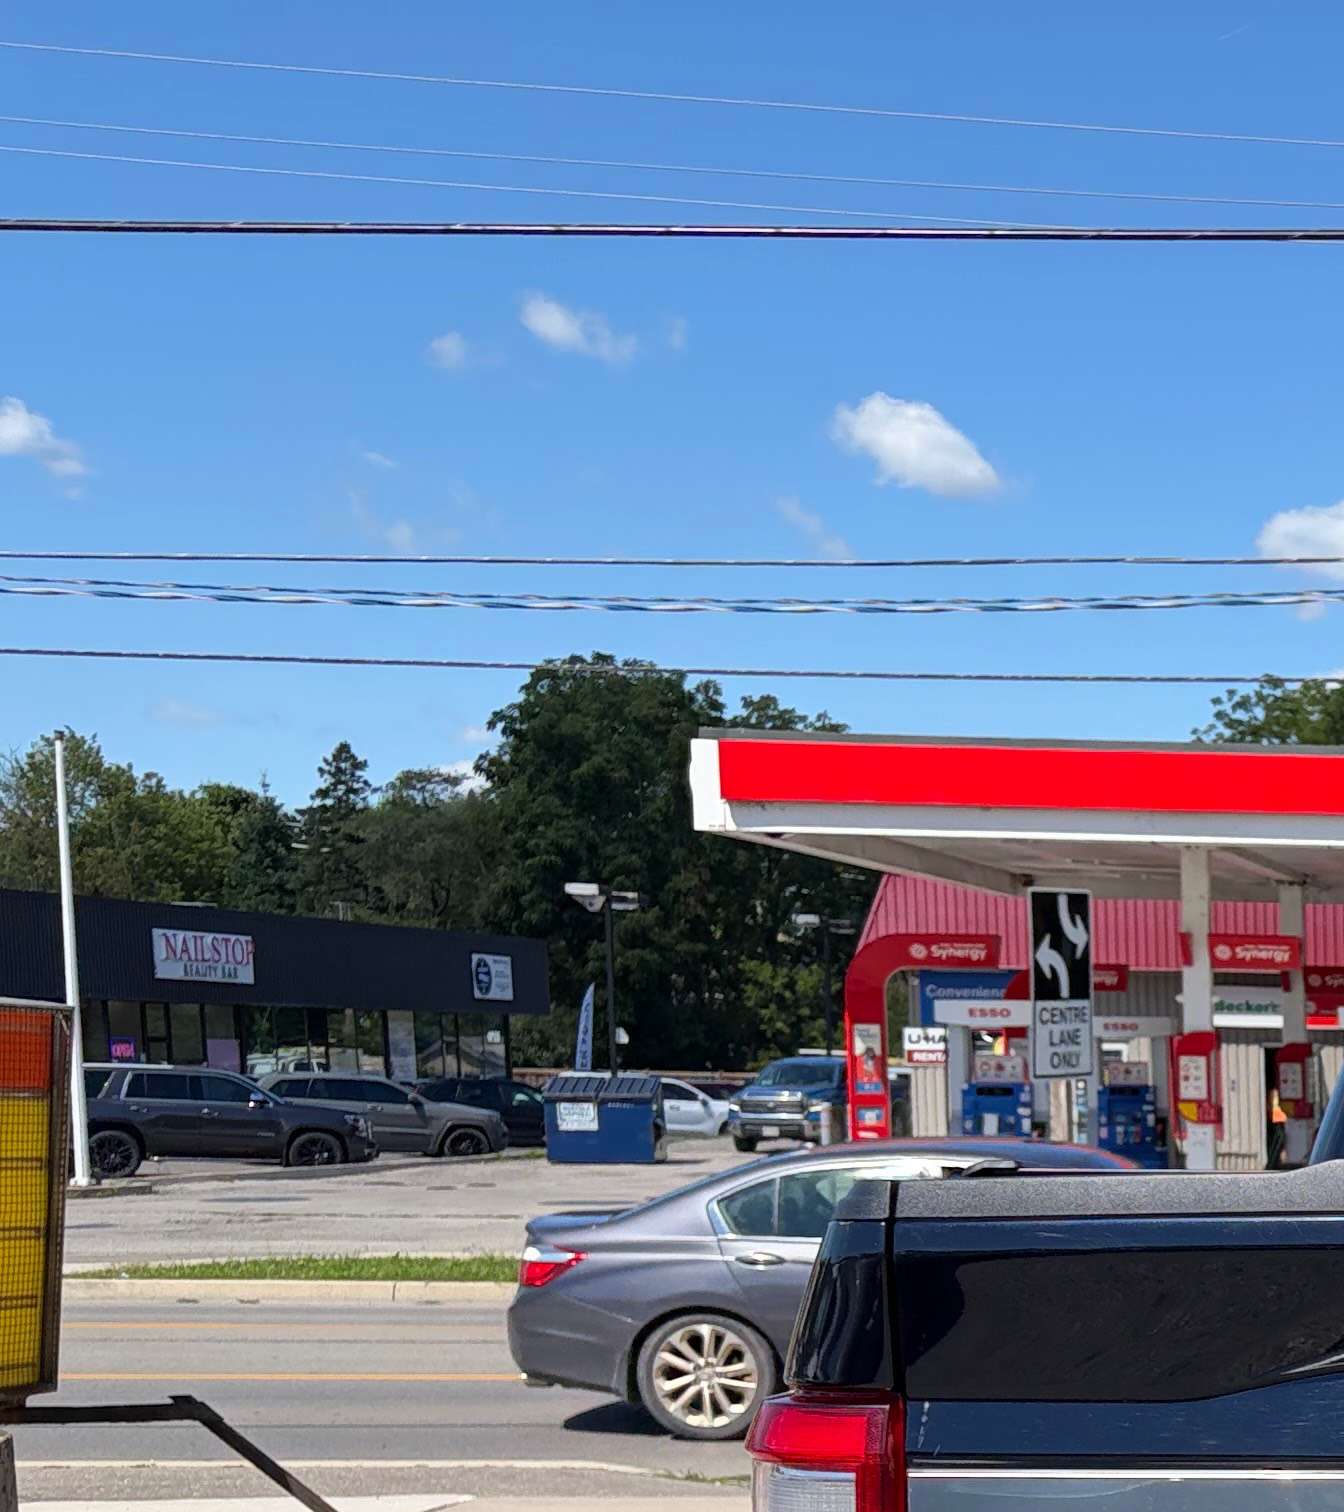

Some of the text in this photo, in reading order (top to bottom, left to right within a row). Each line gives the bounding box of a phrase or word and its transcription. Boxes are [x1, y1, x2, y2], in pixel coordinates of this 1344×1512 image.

[931, 944, 987, 961] Synergy
[1235, 946, 1291, 962] Synergy
[968, 1007, 1011, 1018] ESSO
[1039, 1006, 1088, 1025] CENTRE
[1103, 1022, 1138, 1031] ESSO
[1049, 1028, 1081, 1047] LANE
[1050, 1051, 1080, 1069] ONLY
